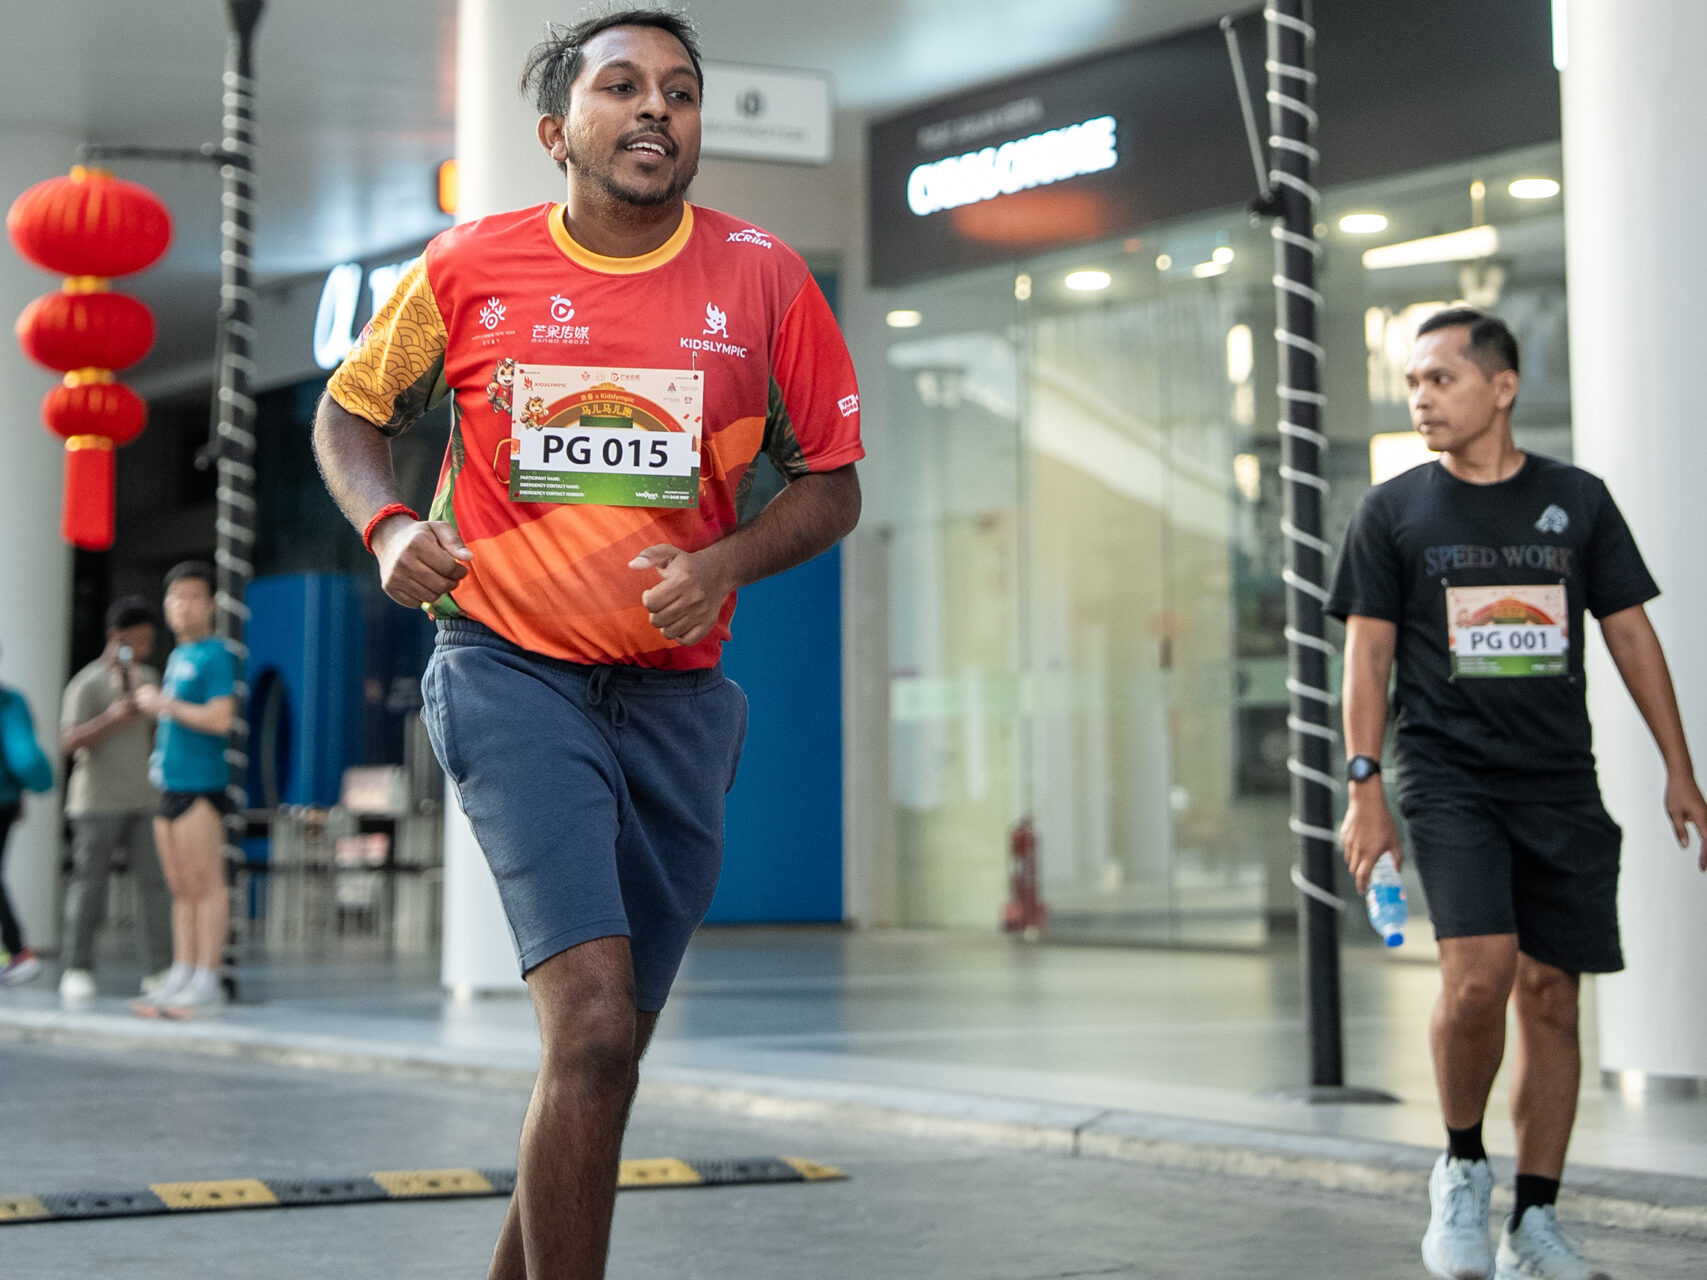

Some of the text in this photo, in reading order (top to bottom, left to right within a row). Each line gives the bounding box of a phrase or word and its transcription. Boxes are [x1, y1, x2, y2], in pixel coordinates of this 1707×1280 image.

[532, 324, 590, 340] 芒果传媒
[680, 337, 748, 358] KIDSLYMPIC
[600, 392, 635, 403] Kidslympic
[543, 434, 668, 468] PG 015
[1424, 544, 1574, 576] SPEED WORK
[1471, 631, 1547, 650] PG 001
